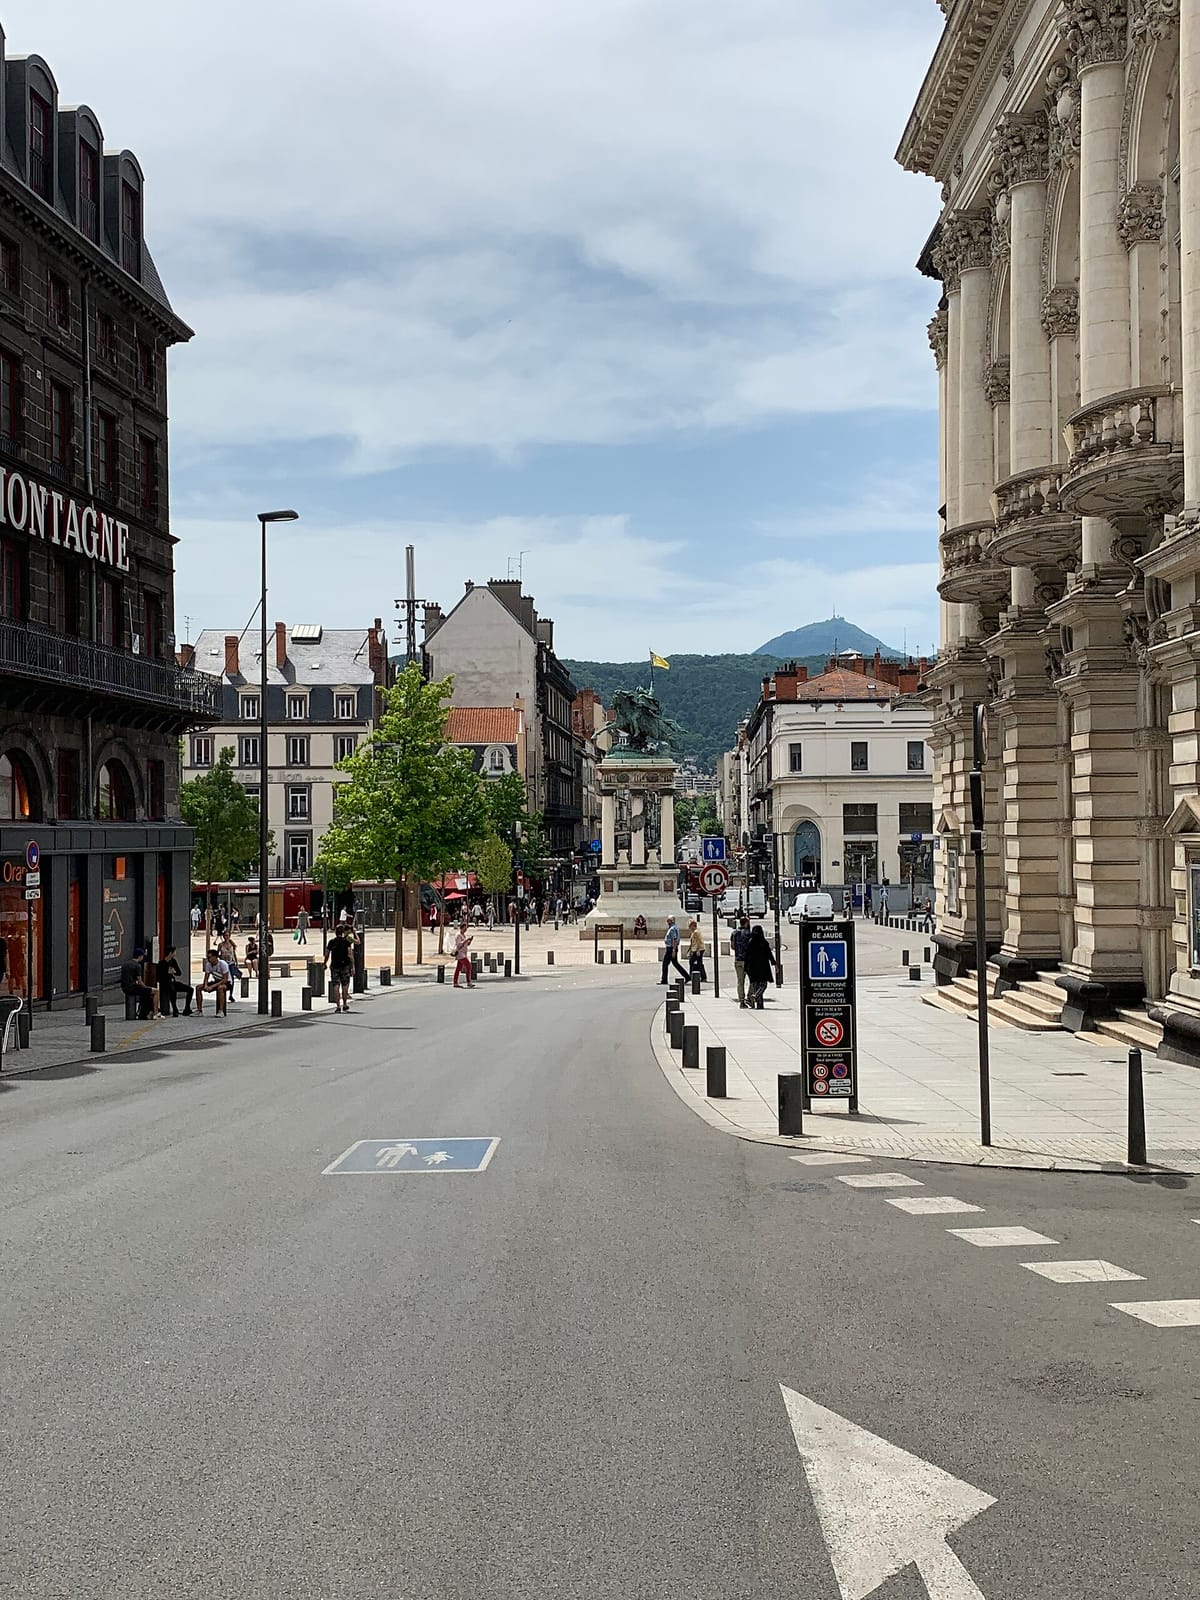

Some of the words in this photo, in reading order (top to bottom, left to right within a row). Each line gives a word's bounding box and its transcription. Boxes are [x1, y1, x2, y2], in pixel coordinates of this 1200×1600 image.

[706, 872, 723, 886] 10
[784, 879, 816, 888] OUVERT
[817, 1067, 825, 1075] 10
